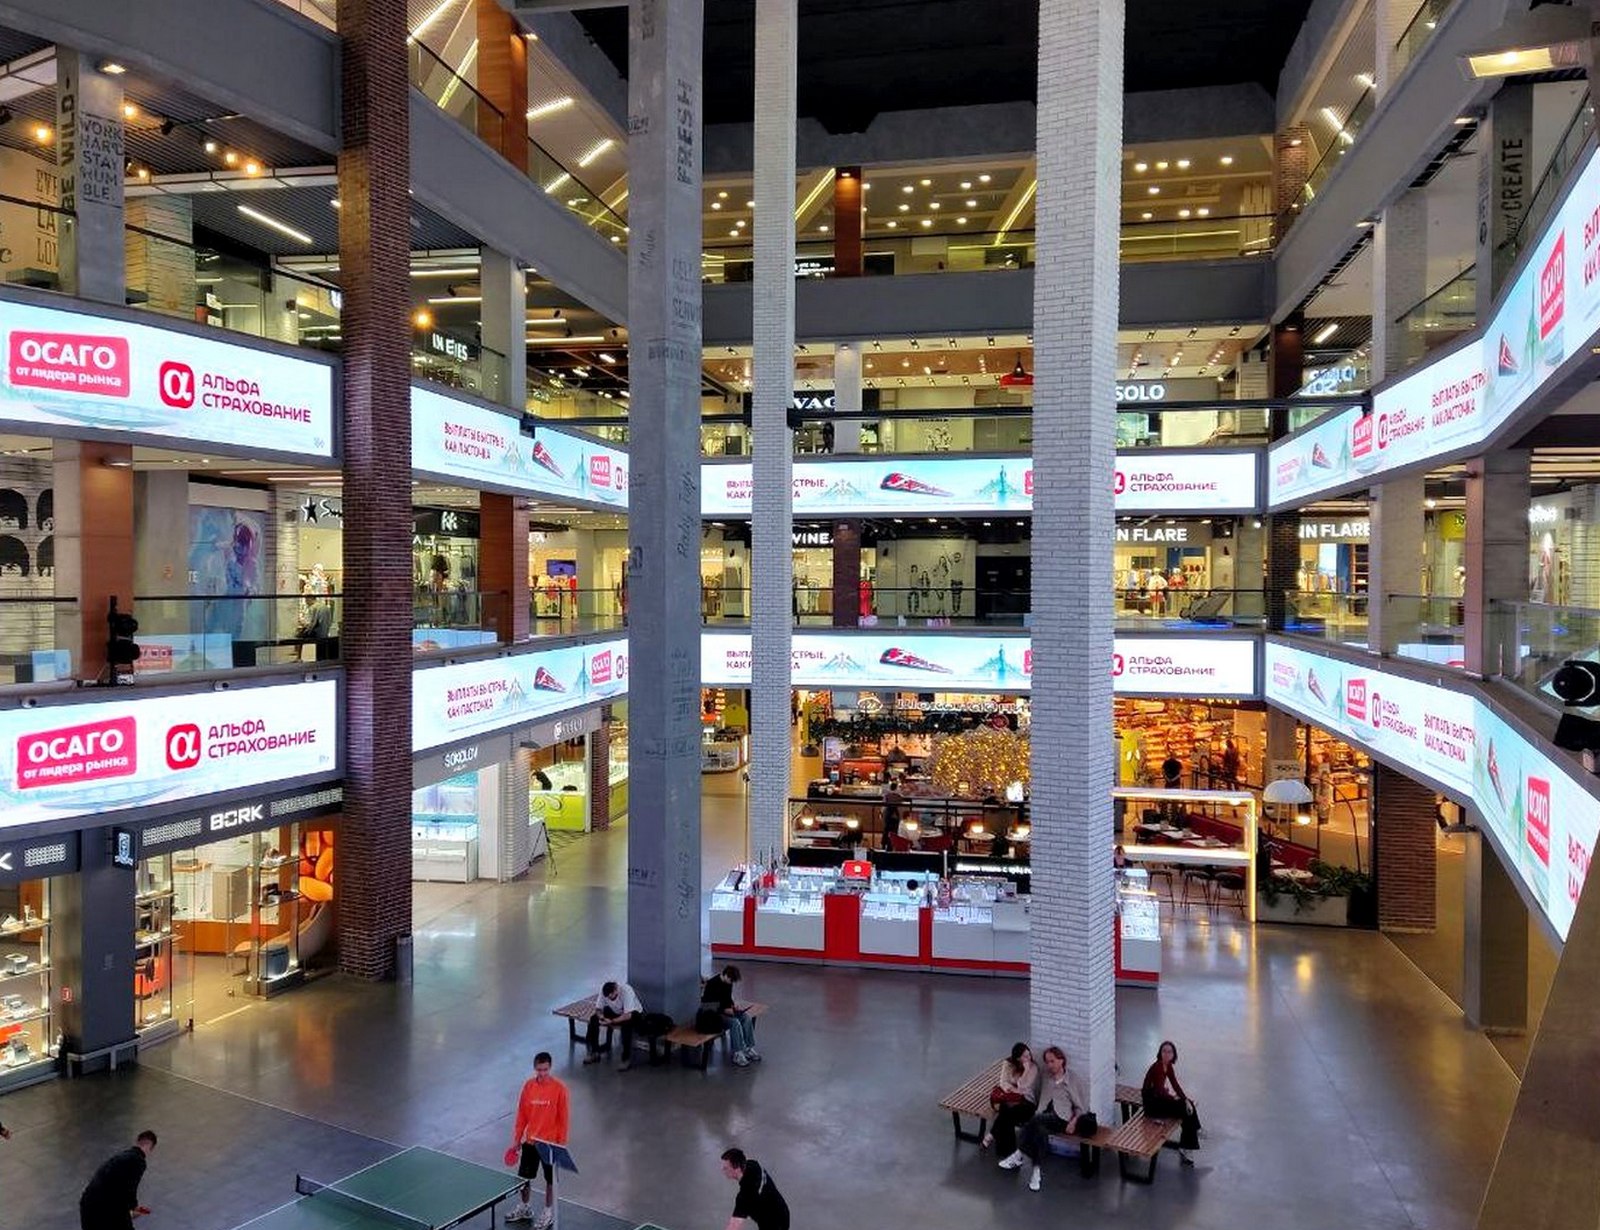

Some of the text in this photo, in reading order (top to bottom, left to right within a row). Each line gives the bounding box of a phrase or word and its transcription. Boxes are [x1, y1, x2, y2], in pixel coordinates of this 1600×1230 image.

[61, 94, 75, 167] WILD
[80, 119, 123, 141] WORK
[83, 150, 117, 171] STAY
[1502, 138, 1523, 212] CREATE
[20, 340, 117, 370] ОСАГО
[16, 366, 122, 389] от лидера рынка
[202, 373, 260, 397] АЛЬФА
[1115, 384, 1165, 401] SOLO
[202, 393, 312, 423] СТРАХОВАНИЕ
[1130, 473, 1175, 482] АЛЬФА
[1130, 482, 1218, 491] СТРАХОВАНИЕ
[727, 490, 747, 499] КАК
[1133, 529, 1187, 541] FLARE
[727, 660, 746, 669] КАК
[1129, 657, 1173, 665] АЛЬФА
[1129, 666, 1215, 676] СТРАХОВАНИЕ
[208, 719, 266, 740] АЛЬФА
[28, 728, 125, 763] ОСАГО
[208, 729, 317, 759] СТРАХОВАНИЕ
[24, 756, 129, 780] от лидера рынка
[210, 804, 263, 831] BORK
